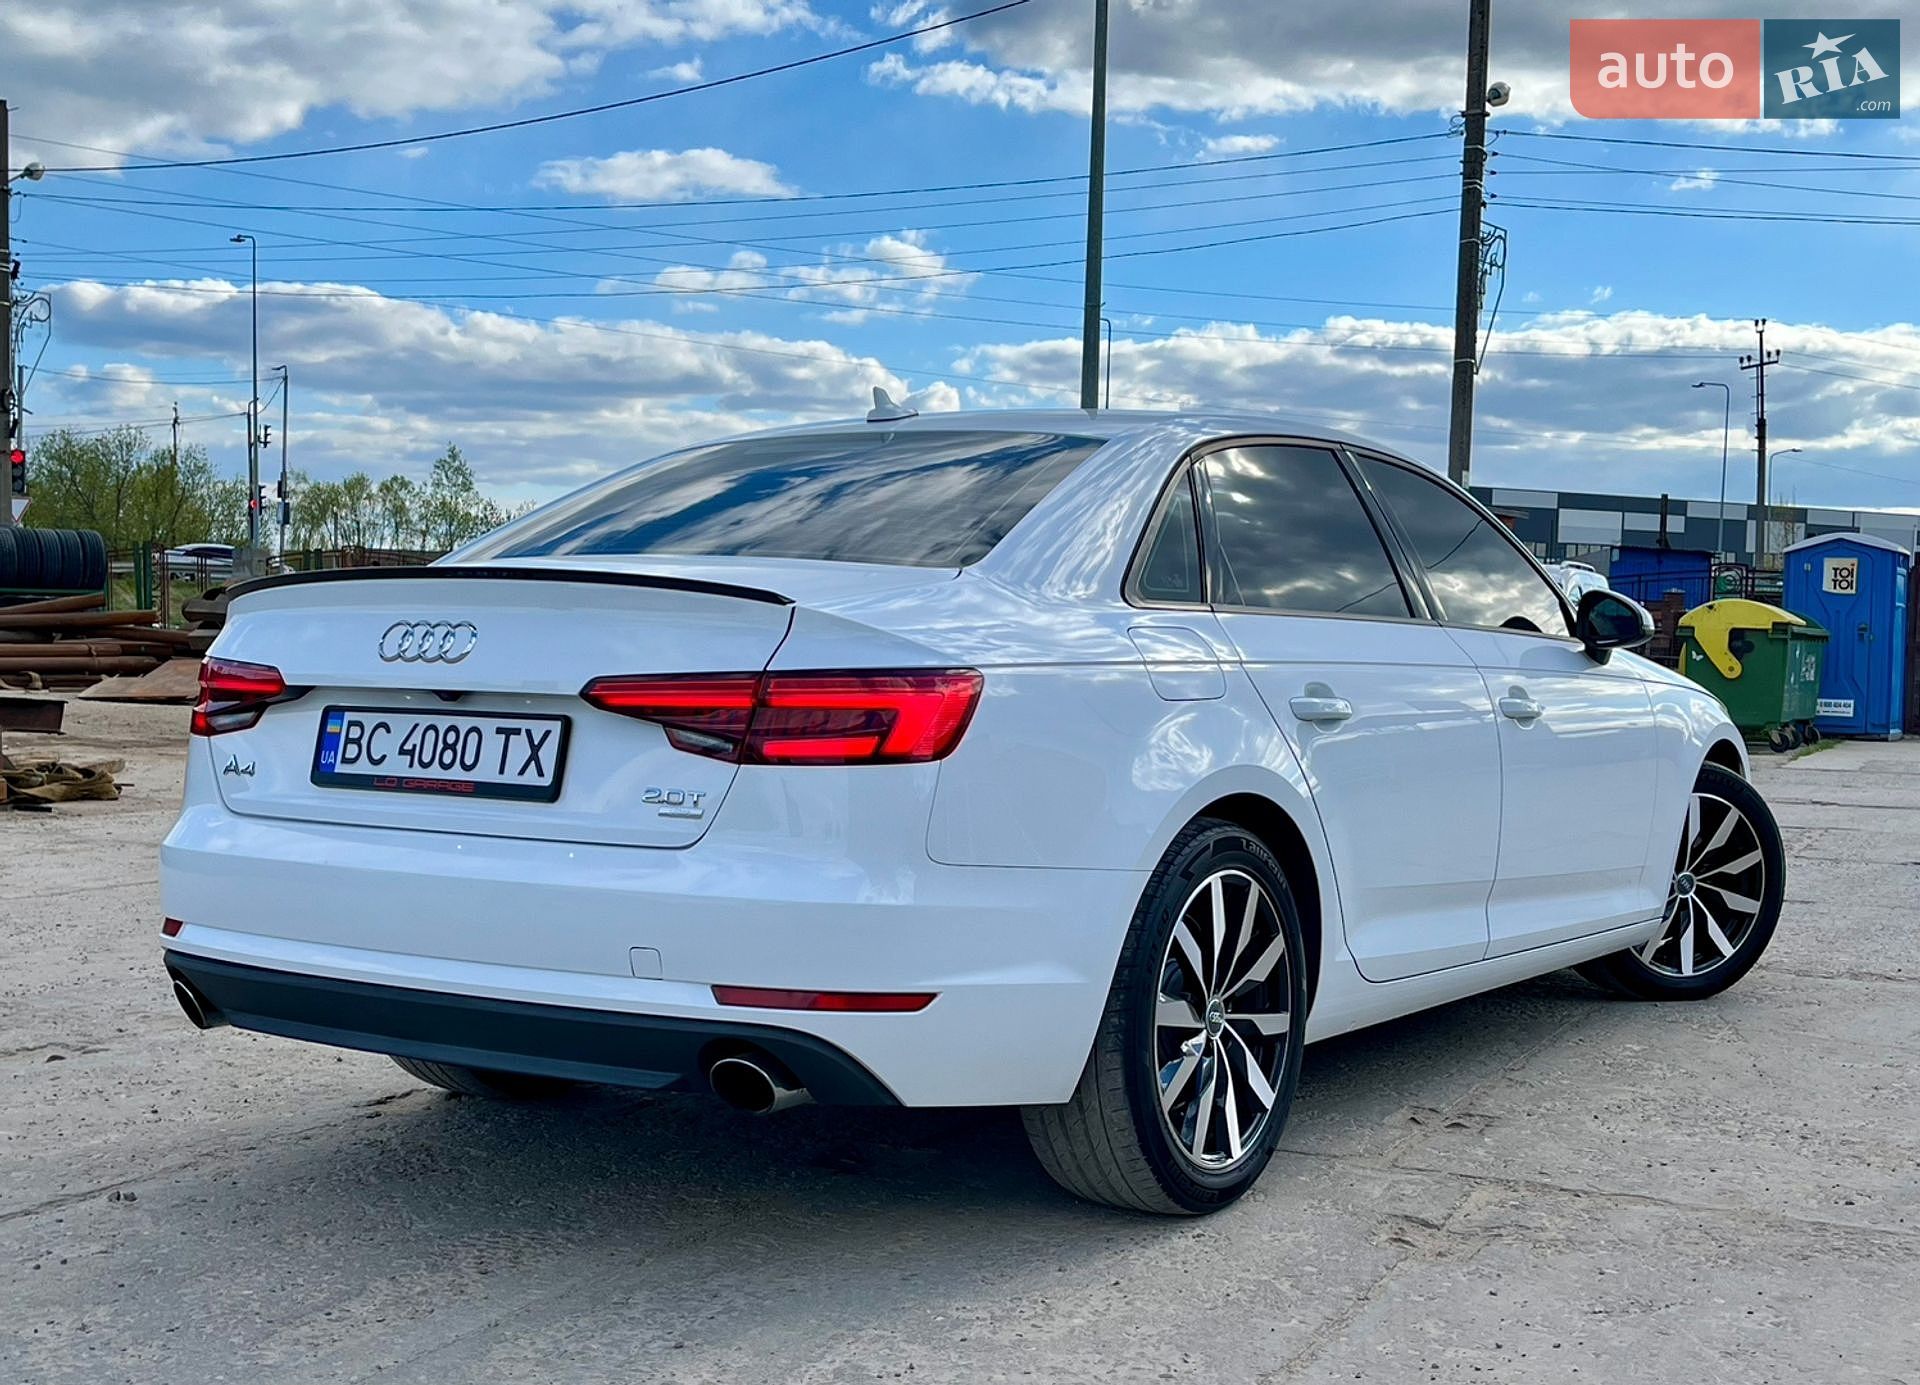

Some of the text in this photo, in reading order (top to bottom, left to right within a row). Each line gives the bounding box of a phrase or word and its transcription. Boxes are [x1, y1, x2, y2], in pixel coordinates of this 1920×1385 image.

[1832, 579, 1853, 590] TOI
[341, 720, 552, 777] BC 4080 TX
[223, 753, 256, 776] A4
[320, 750, 335, 764] UA
[402, 778, 475, 793] GARAGE
